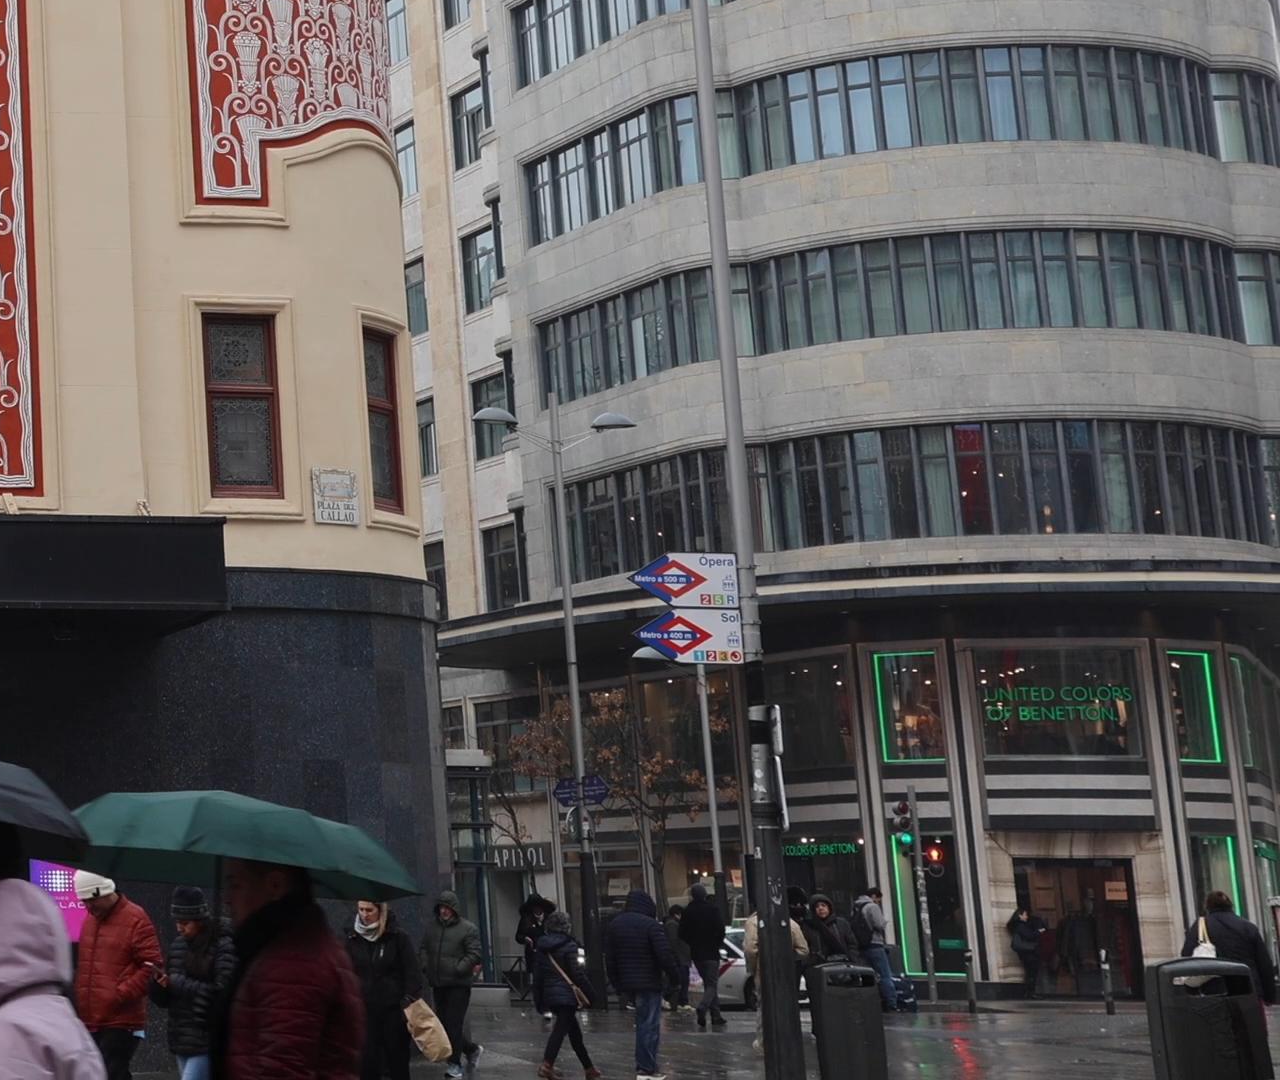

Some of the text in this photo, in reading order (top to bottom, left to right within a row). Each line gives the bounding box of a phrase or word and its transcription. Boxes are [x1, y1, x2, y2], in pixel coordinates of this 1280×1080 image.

[317, 501, 340, 510] PLAZA
[320, 511, 355, 522] CALLAO
[699, 552, 734, 568] Ópera
[663, 575, 678, 583] 500
[702, 595, 710, 604] 2
[727, 596, 735, 604] R
[721, 613, 739, 623] Sol
[640, 631, 662, 639] Metro
[669, 631, 683, 639] 400
[707, 651, 716, 660] 2
[985, 686, 1133, 701] UNITED COLORS
[987, 706, 1012, 720] OF
[785, 845, 809, 856] COLORS
[809, 844, 817, 855] OF
[493, 847, 545, 868] APITOL
